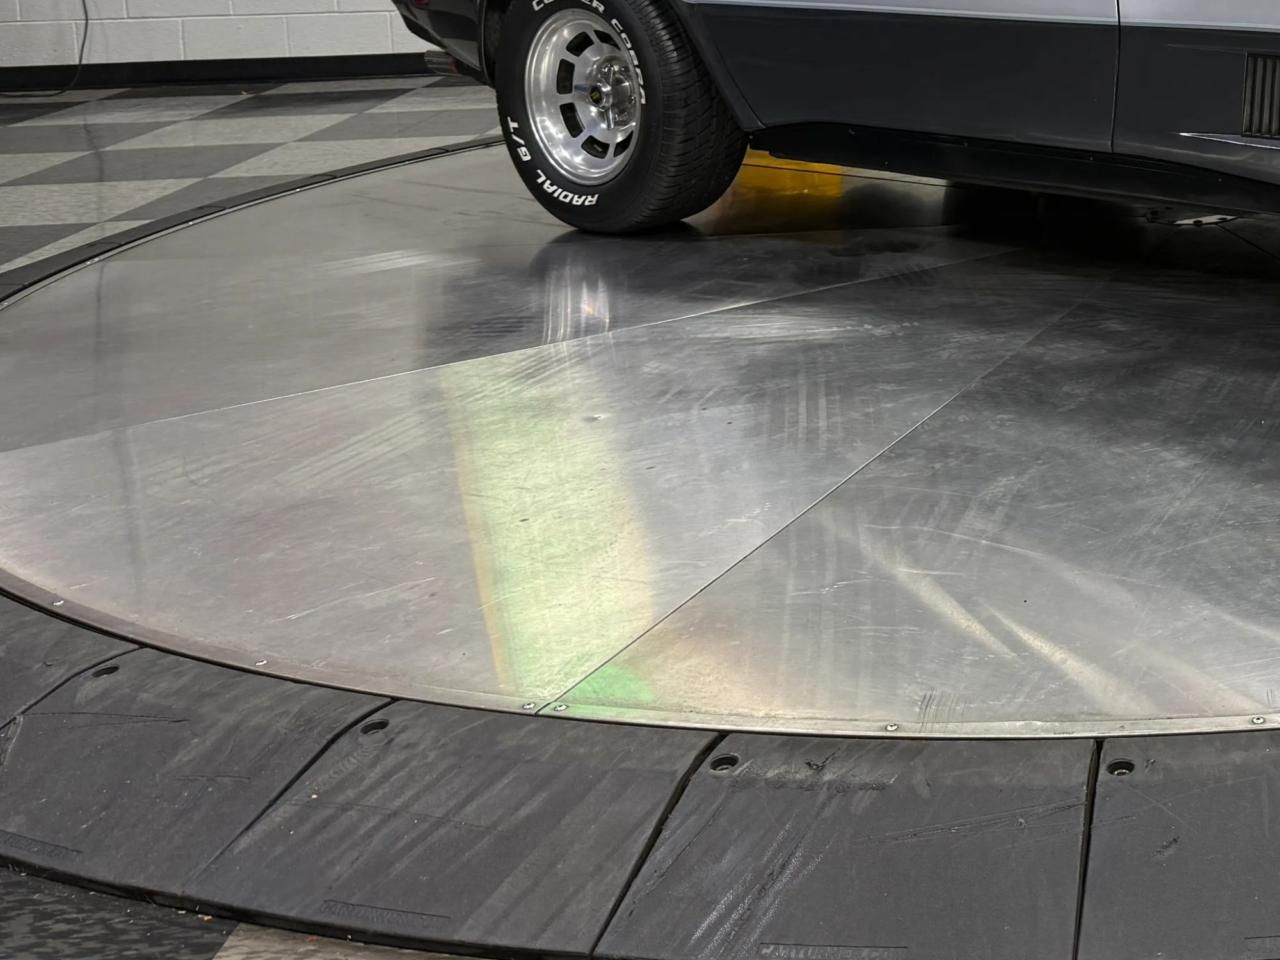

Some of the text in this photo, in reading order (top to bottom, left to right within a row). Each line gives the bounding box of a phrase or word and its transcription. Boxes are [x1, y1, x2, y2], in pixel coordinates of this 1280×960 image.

[610, 18, 647, 105] COBRA
[506, 116, 601, 207] RADIAL G/T
